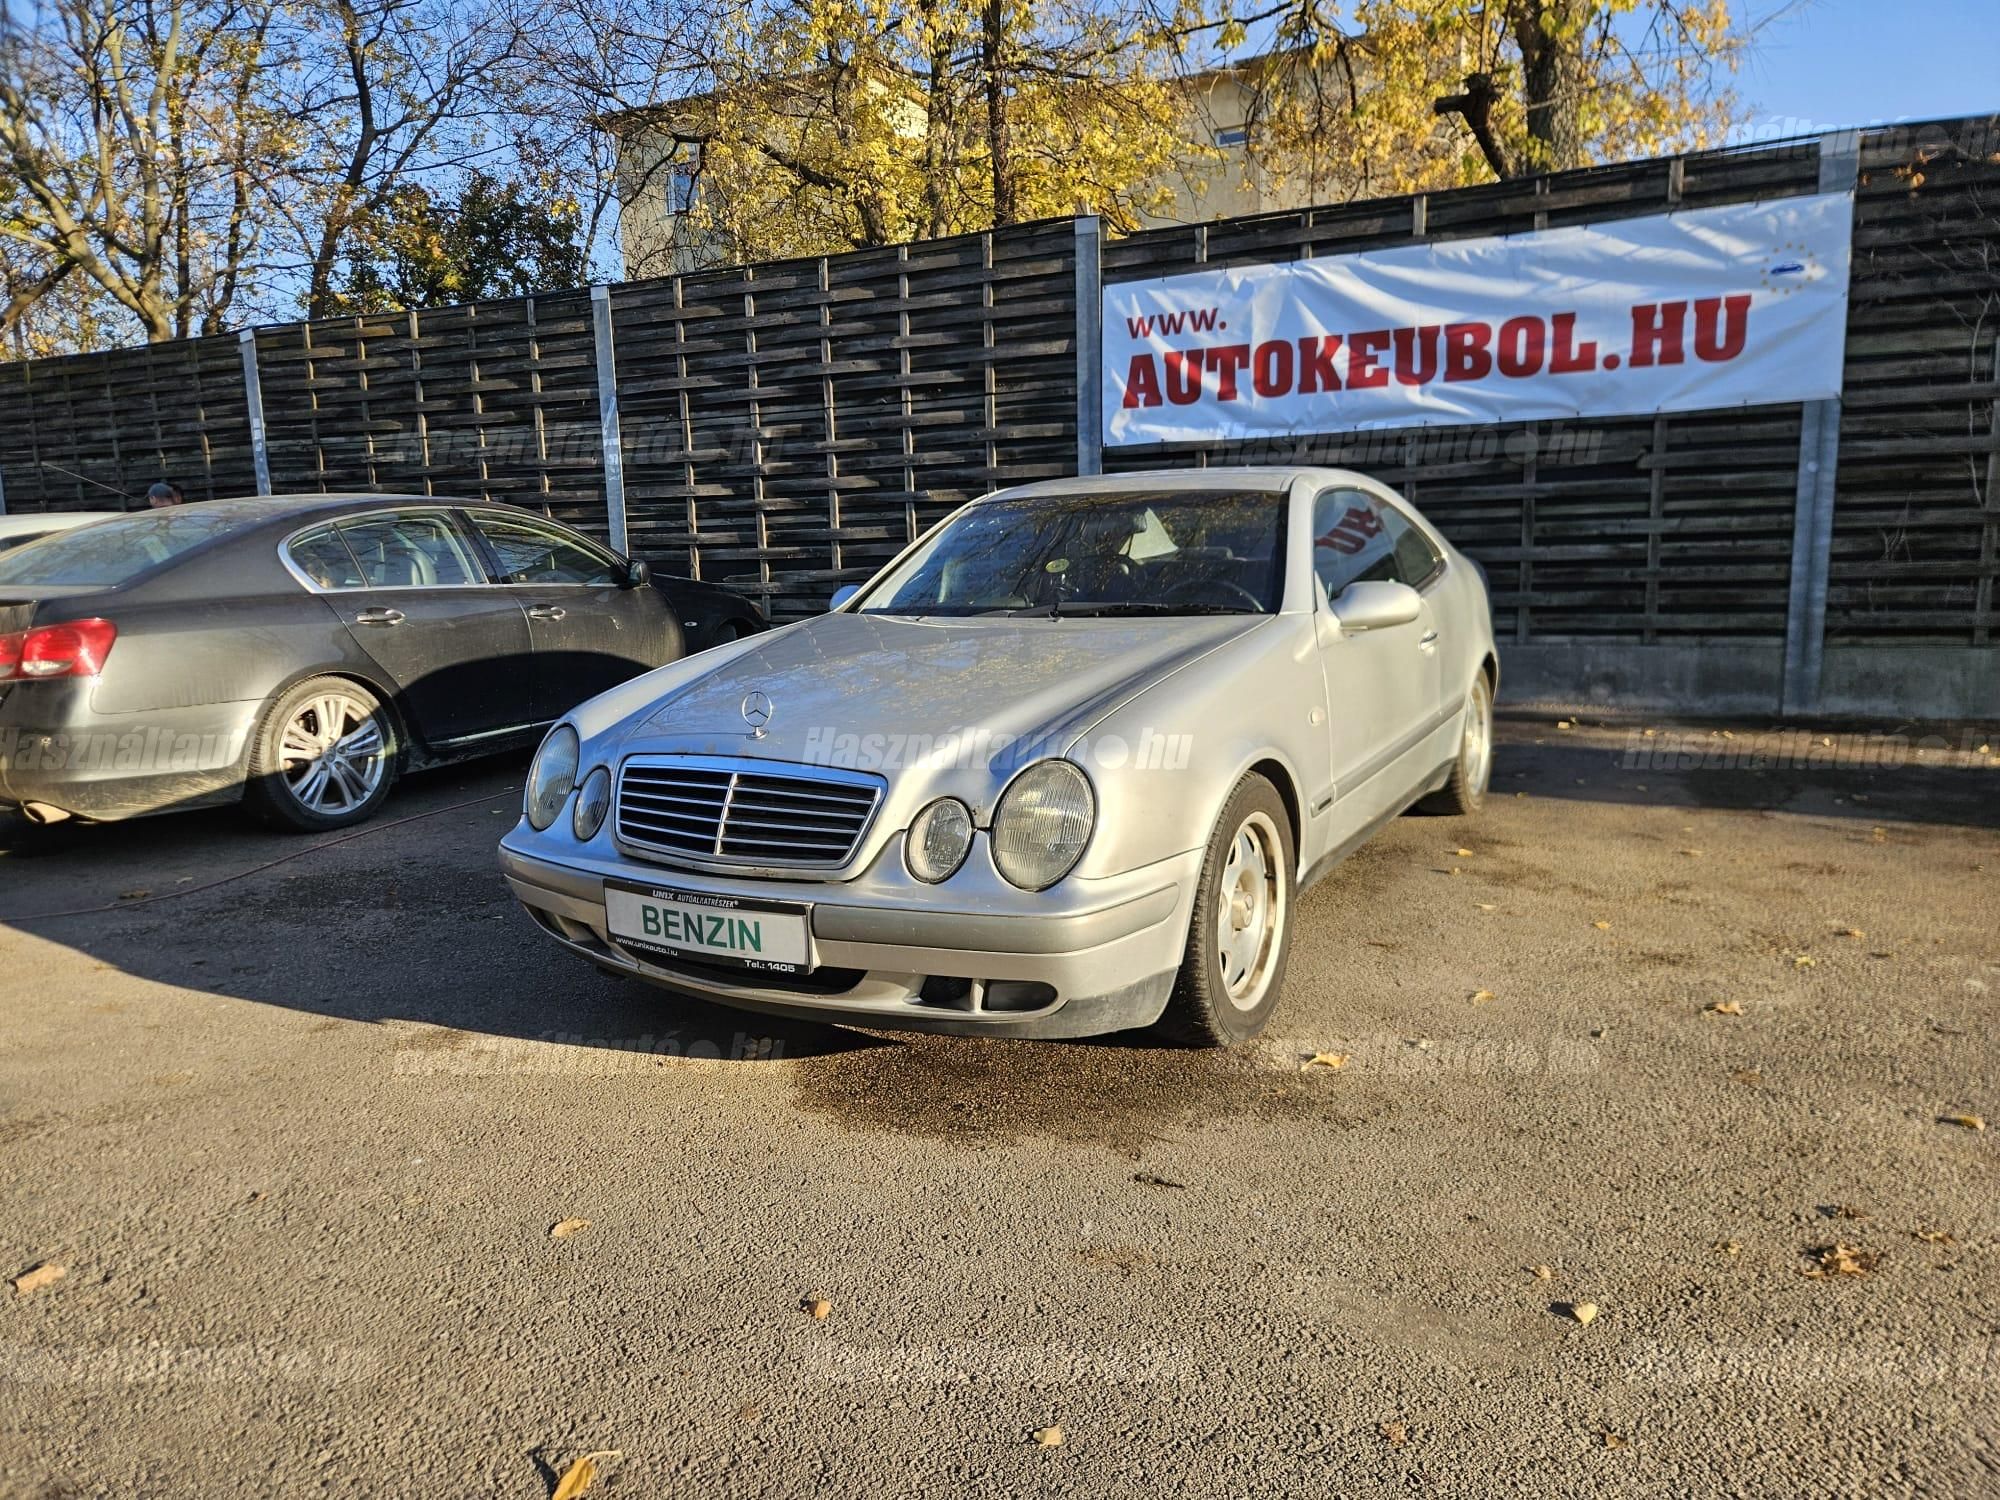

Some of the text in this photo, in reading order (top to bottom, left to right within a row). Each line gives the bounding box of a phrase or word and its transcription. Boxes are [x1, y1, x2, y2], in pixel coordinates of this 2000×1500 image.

[1127, 307, 1227, 340] www.
[1122, 294, 1752, 409] AUTOKEUBOL.HU
[652, 889, 674, 900] UNIX
[642, 904, 761, 952] BENZIN
[744, 960, 796, 973] Tel.: 1405
